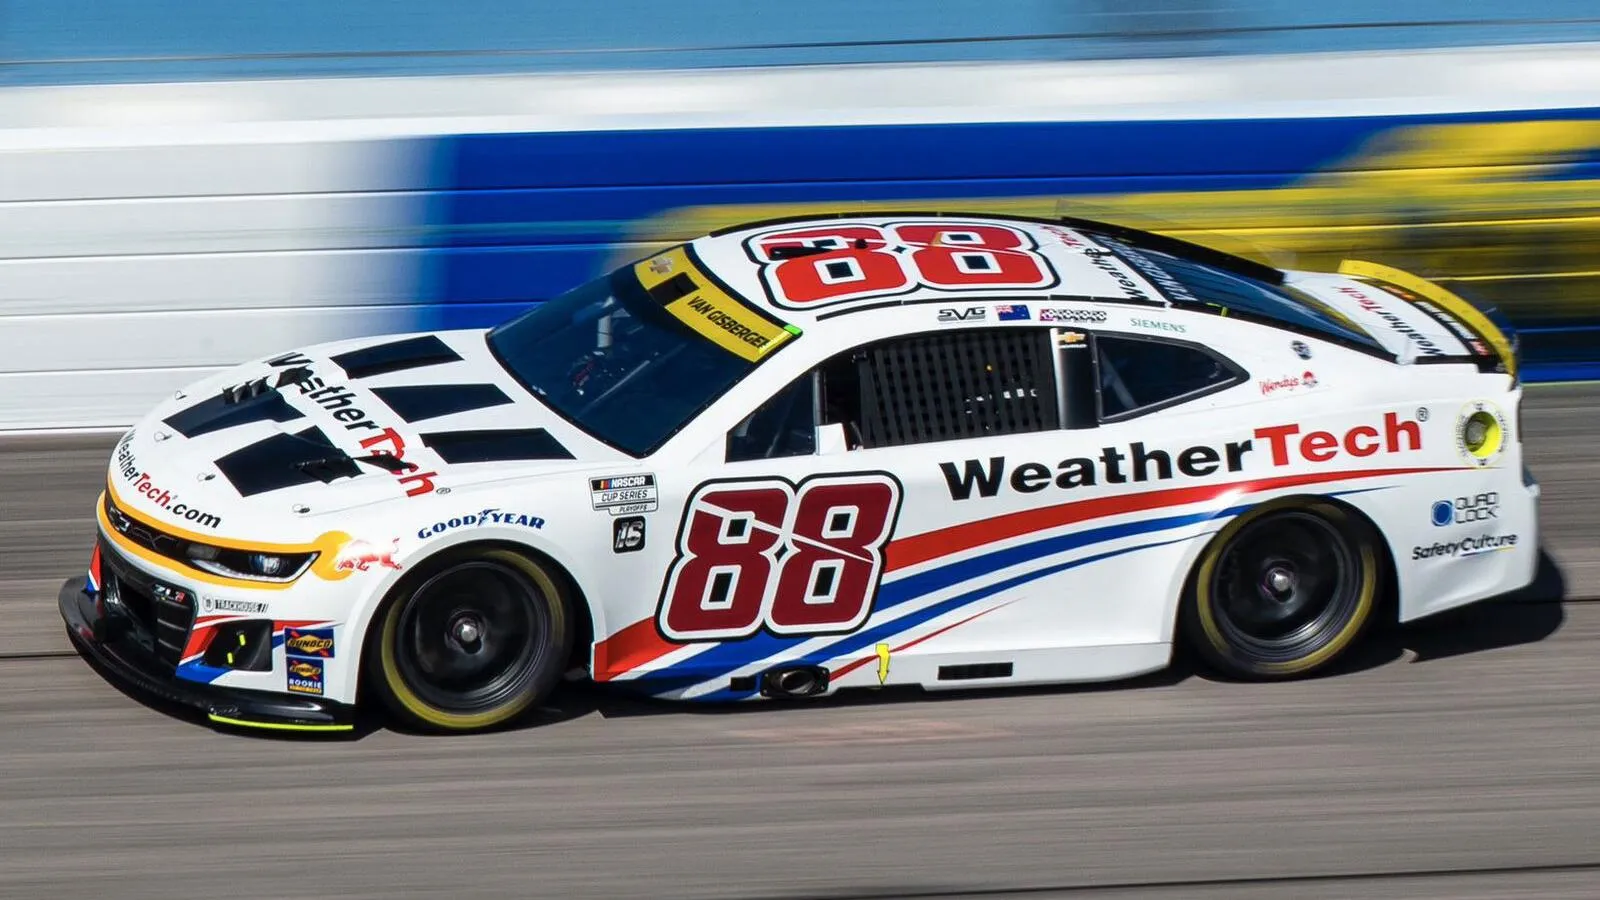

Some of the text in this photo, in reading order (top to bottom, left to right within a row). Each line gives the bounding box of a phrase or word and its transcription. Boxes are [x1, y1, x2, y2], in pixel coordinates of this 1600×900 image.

[742, 220, 1061, 310] 88
[687, 296, 716, 315] VAN
[938, 306, 986, 320] SVG
[1131, 318, 1186, 333] SIEMENS
[939, 411, 1422, 501] WeatherTech
[612, 476, 646, 489] NASCAR
[601, 489, 648, 502] CUP SERIES
[619, 504, 648, 513] PLAYOFFS
[1455, 506, 1500, 524] LOCK
[1411, 533, 1518, 561] SafetyCulture
[655, 470, 903, 642] 88
[288, 639, 332, 648] SUNOCO
[288, 678, 323, 688] ROOKIE
